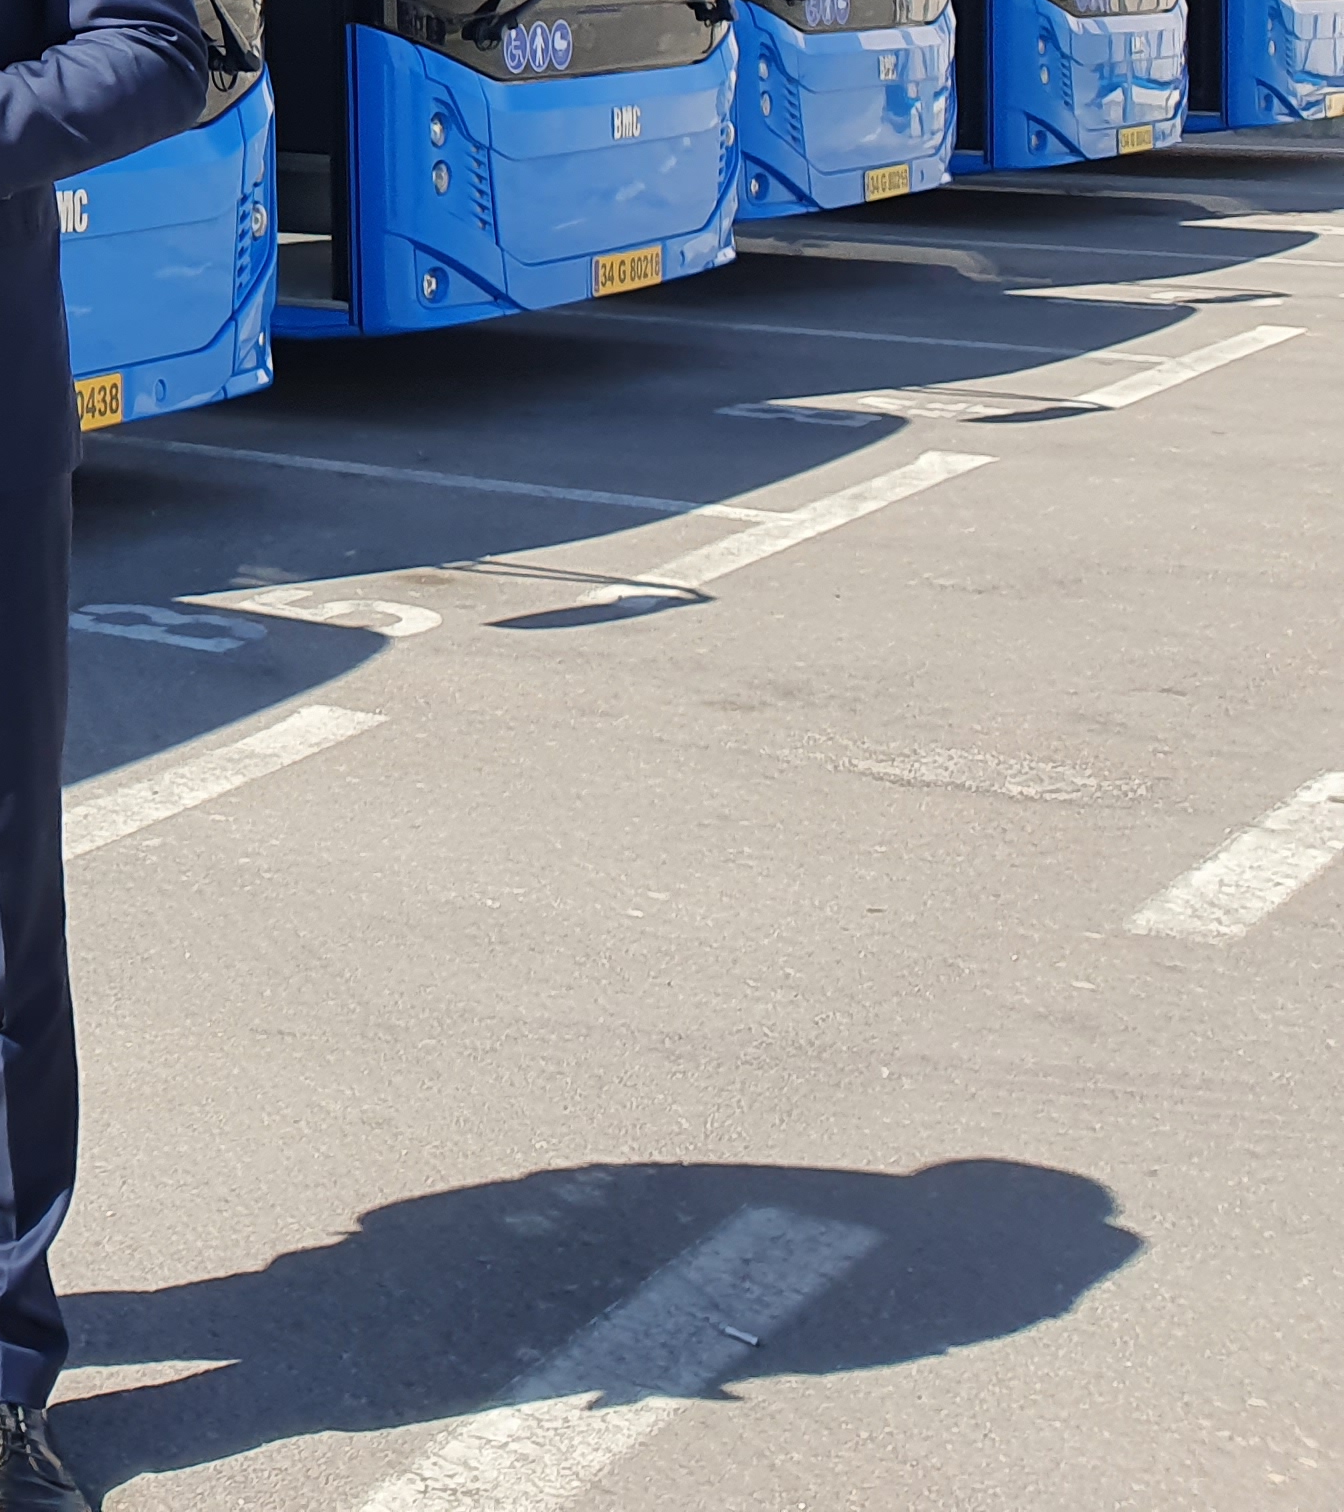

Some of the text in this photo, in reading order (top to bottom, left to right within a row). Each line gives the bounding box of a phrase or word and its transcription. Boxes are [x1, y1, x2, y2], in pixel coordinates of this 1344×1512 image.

[613, 104, 641, 140] BMC
[56, 188, 88, 234] MC
[600, 252, 660, 288] 34 G 80218
[76, 381, 120, 420] 0438
